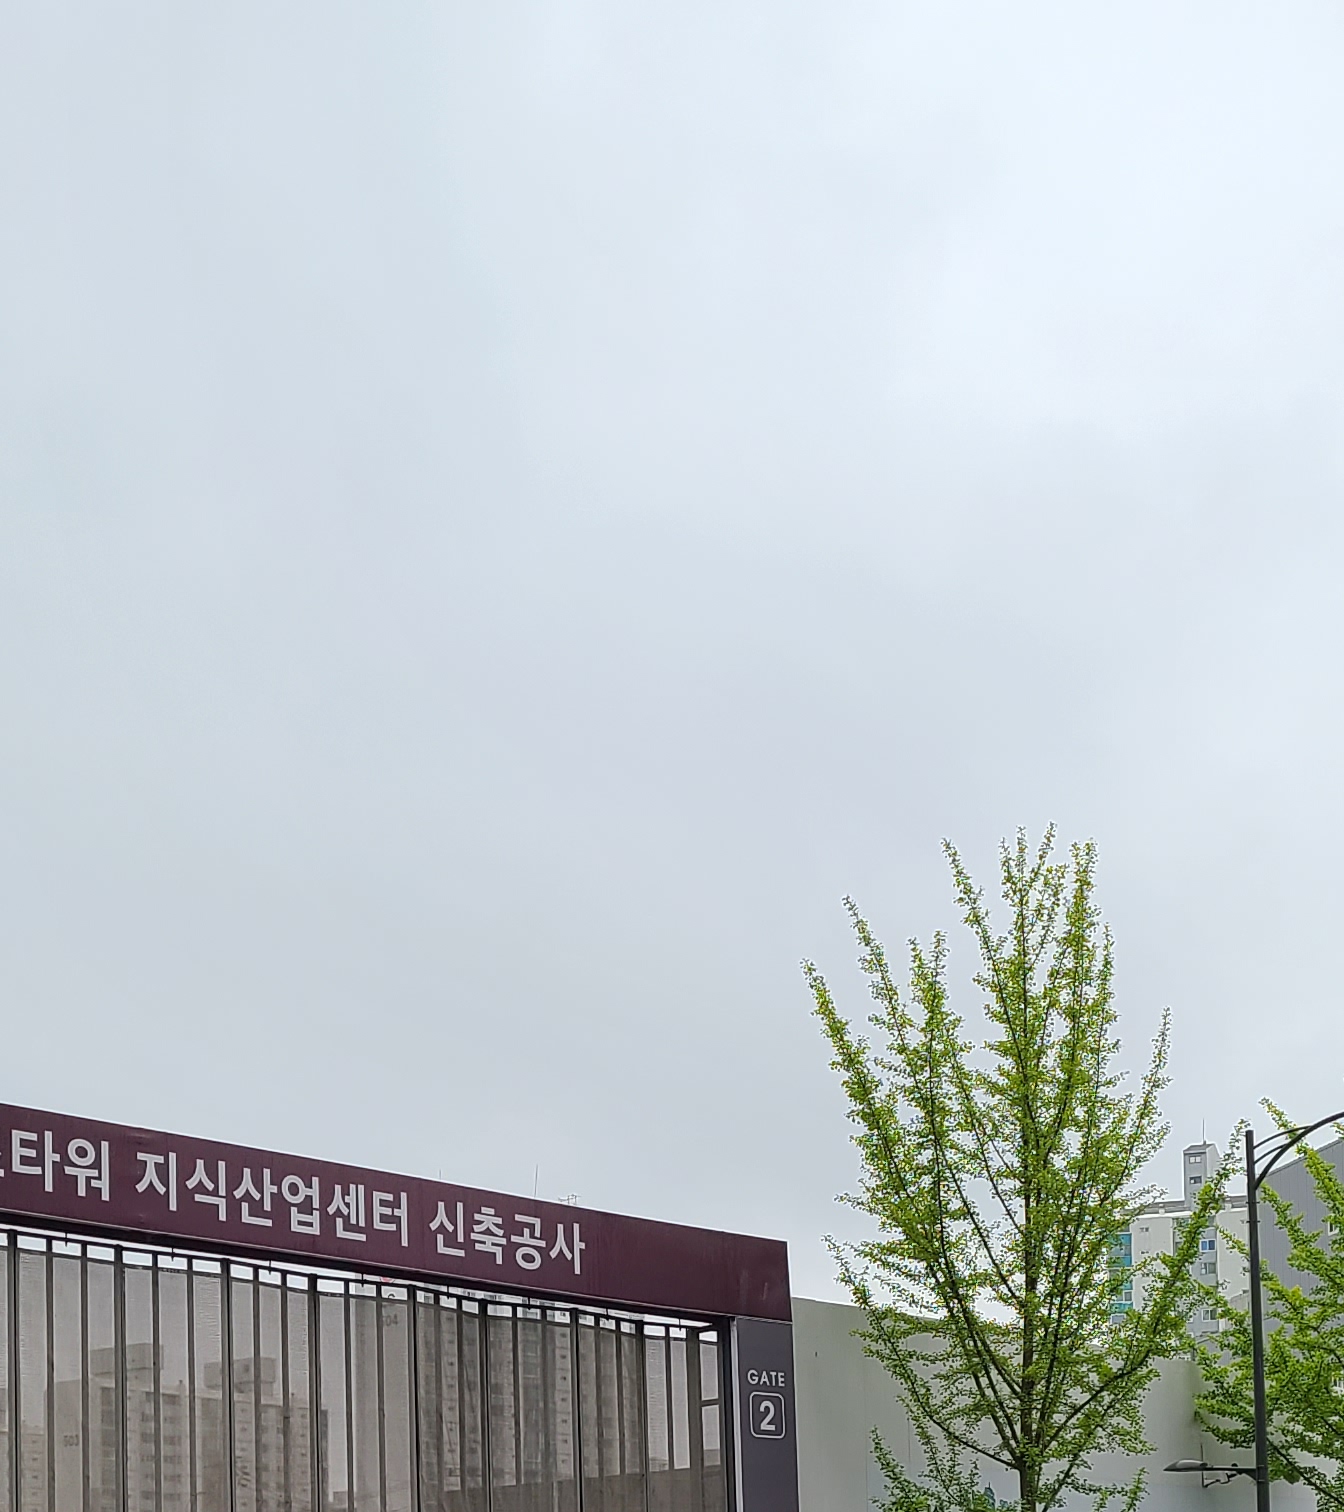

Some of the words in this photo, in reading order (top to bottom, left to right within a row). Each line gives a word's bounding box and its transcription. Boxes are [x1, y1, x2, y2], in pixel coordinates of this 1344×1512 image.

[135, 1151, 409, 1246] 지식산업센터
[429, 1201, 585, 1275] 신축공사
[748, 1370, 785, 1387] GATE
[759, 1400, 776, 1431] 2
